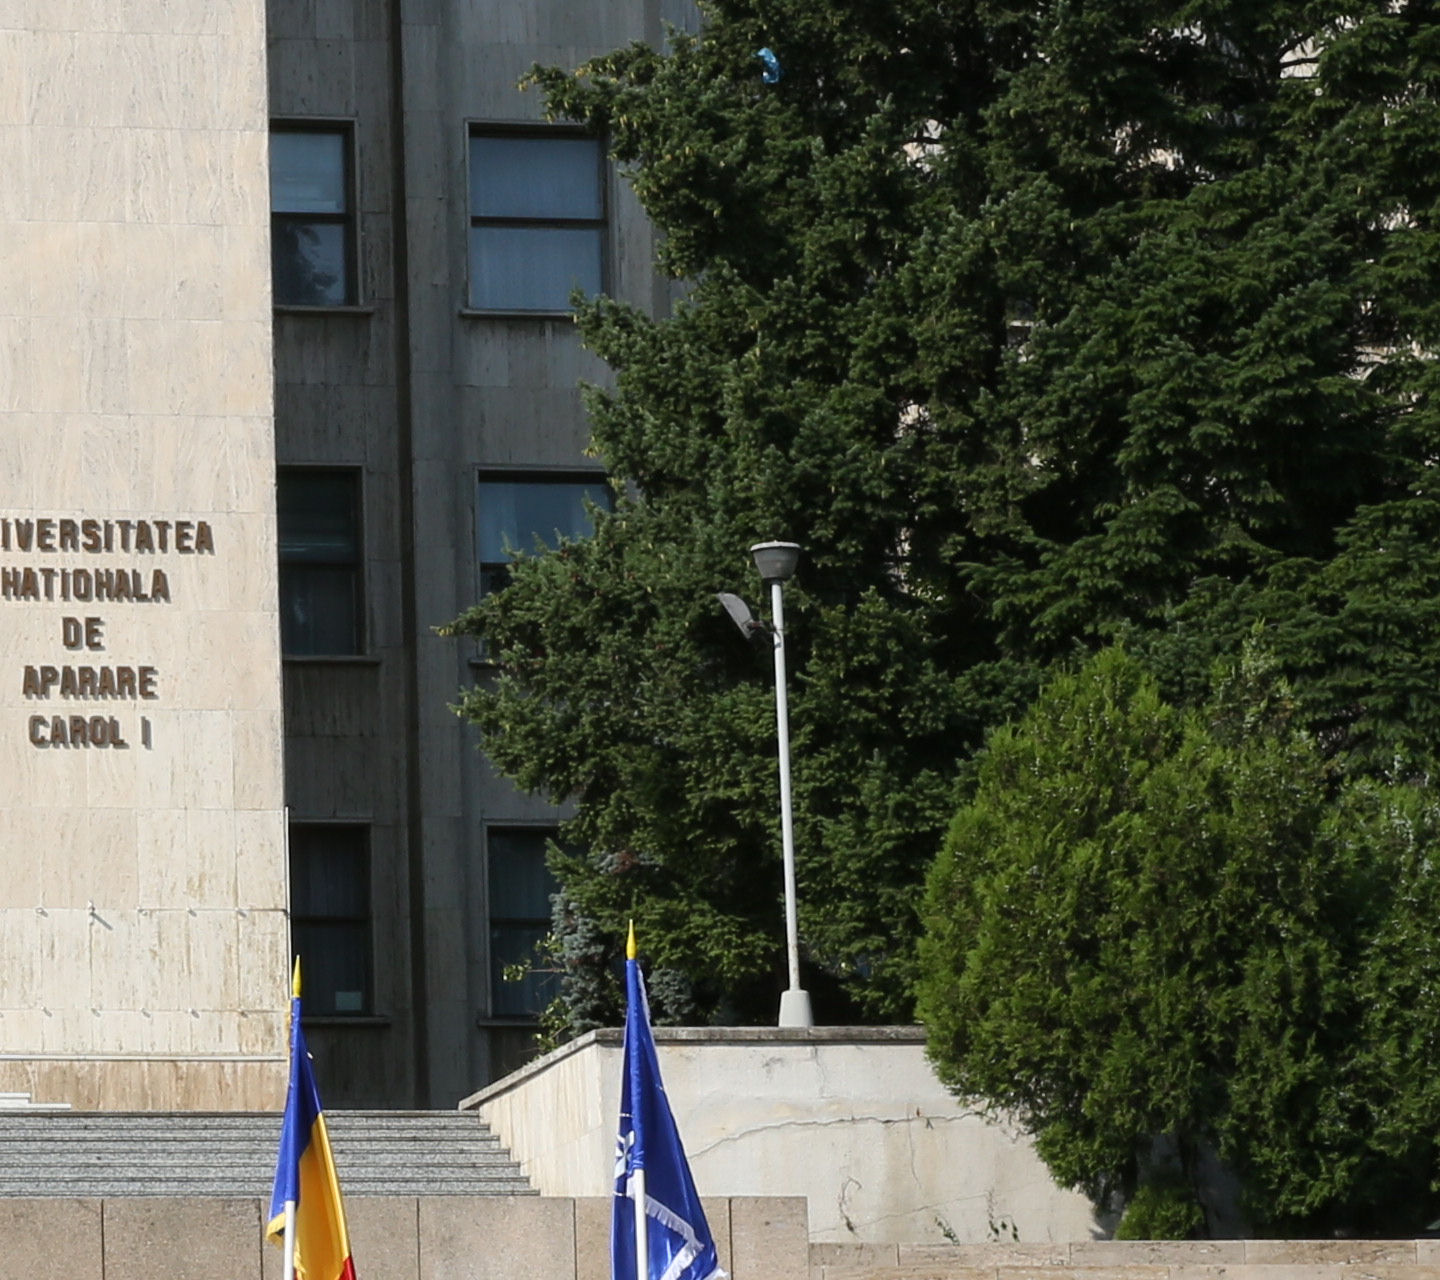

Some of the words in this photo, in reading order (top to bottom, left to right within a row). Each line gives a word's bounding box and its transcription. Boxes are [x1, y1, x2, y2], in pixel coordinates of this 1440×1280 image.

[1, 567, 171, 603] NATIONALA
[62, 616, 105, 651] DE
[23, 665, 159, 701] APARARE
[29, 715, 124, 749] CAROL
[140, 716, 152, 750] I
